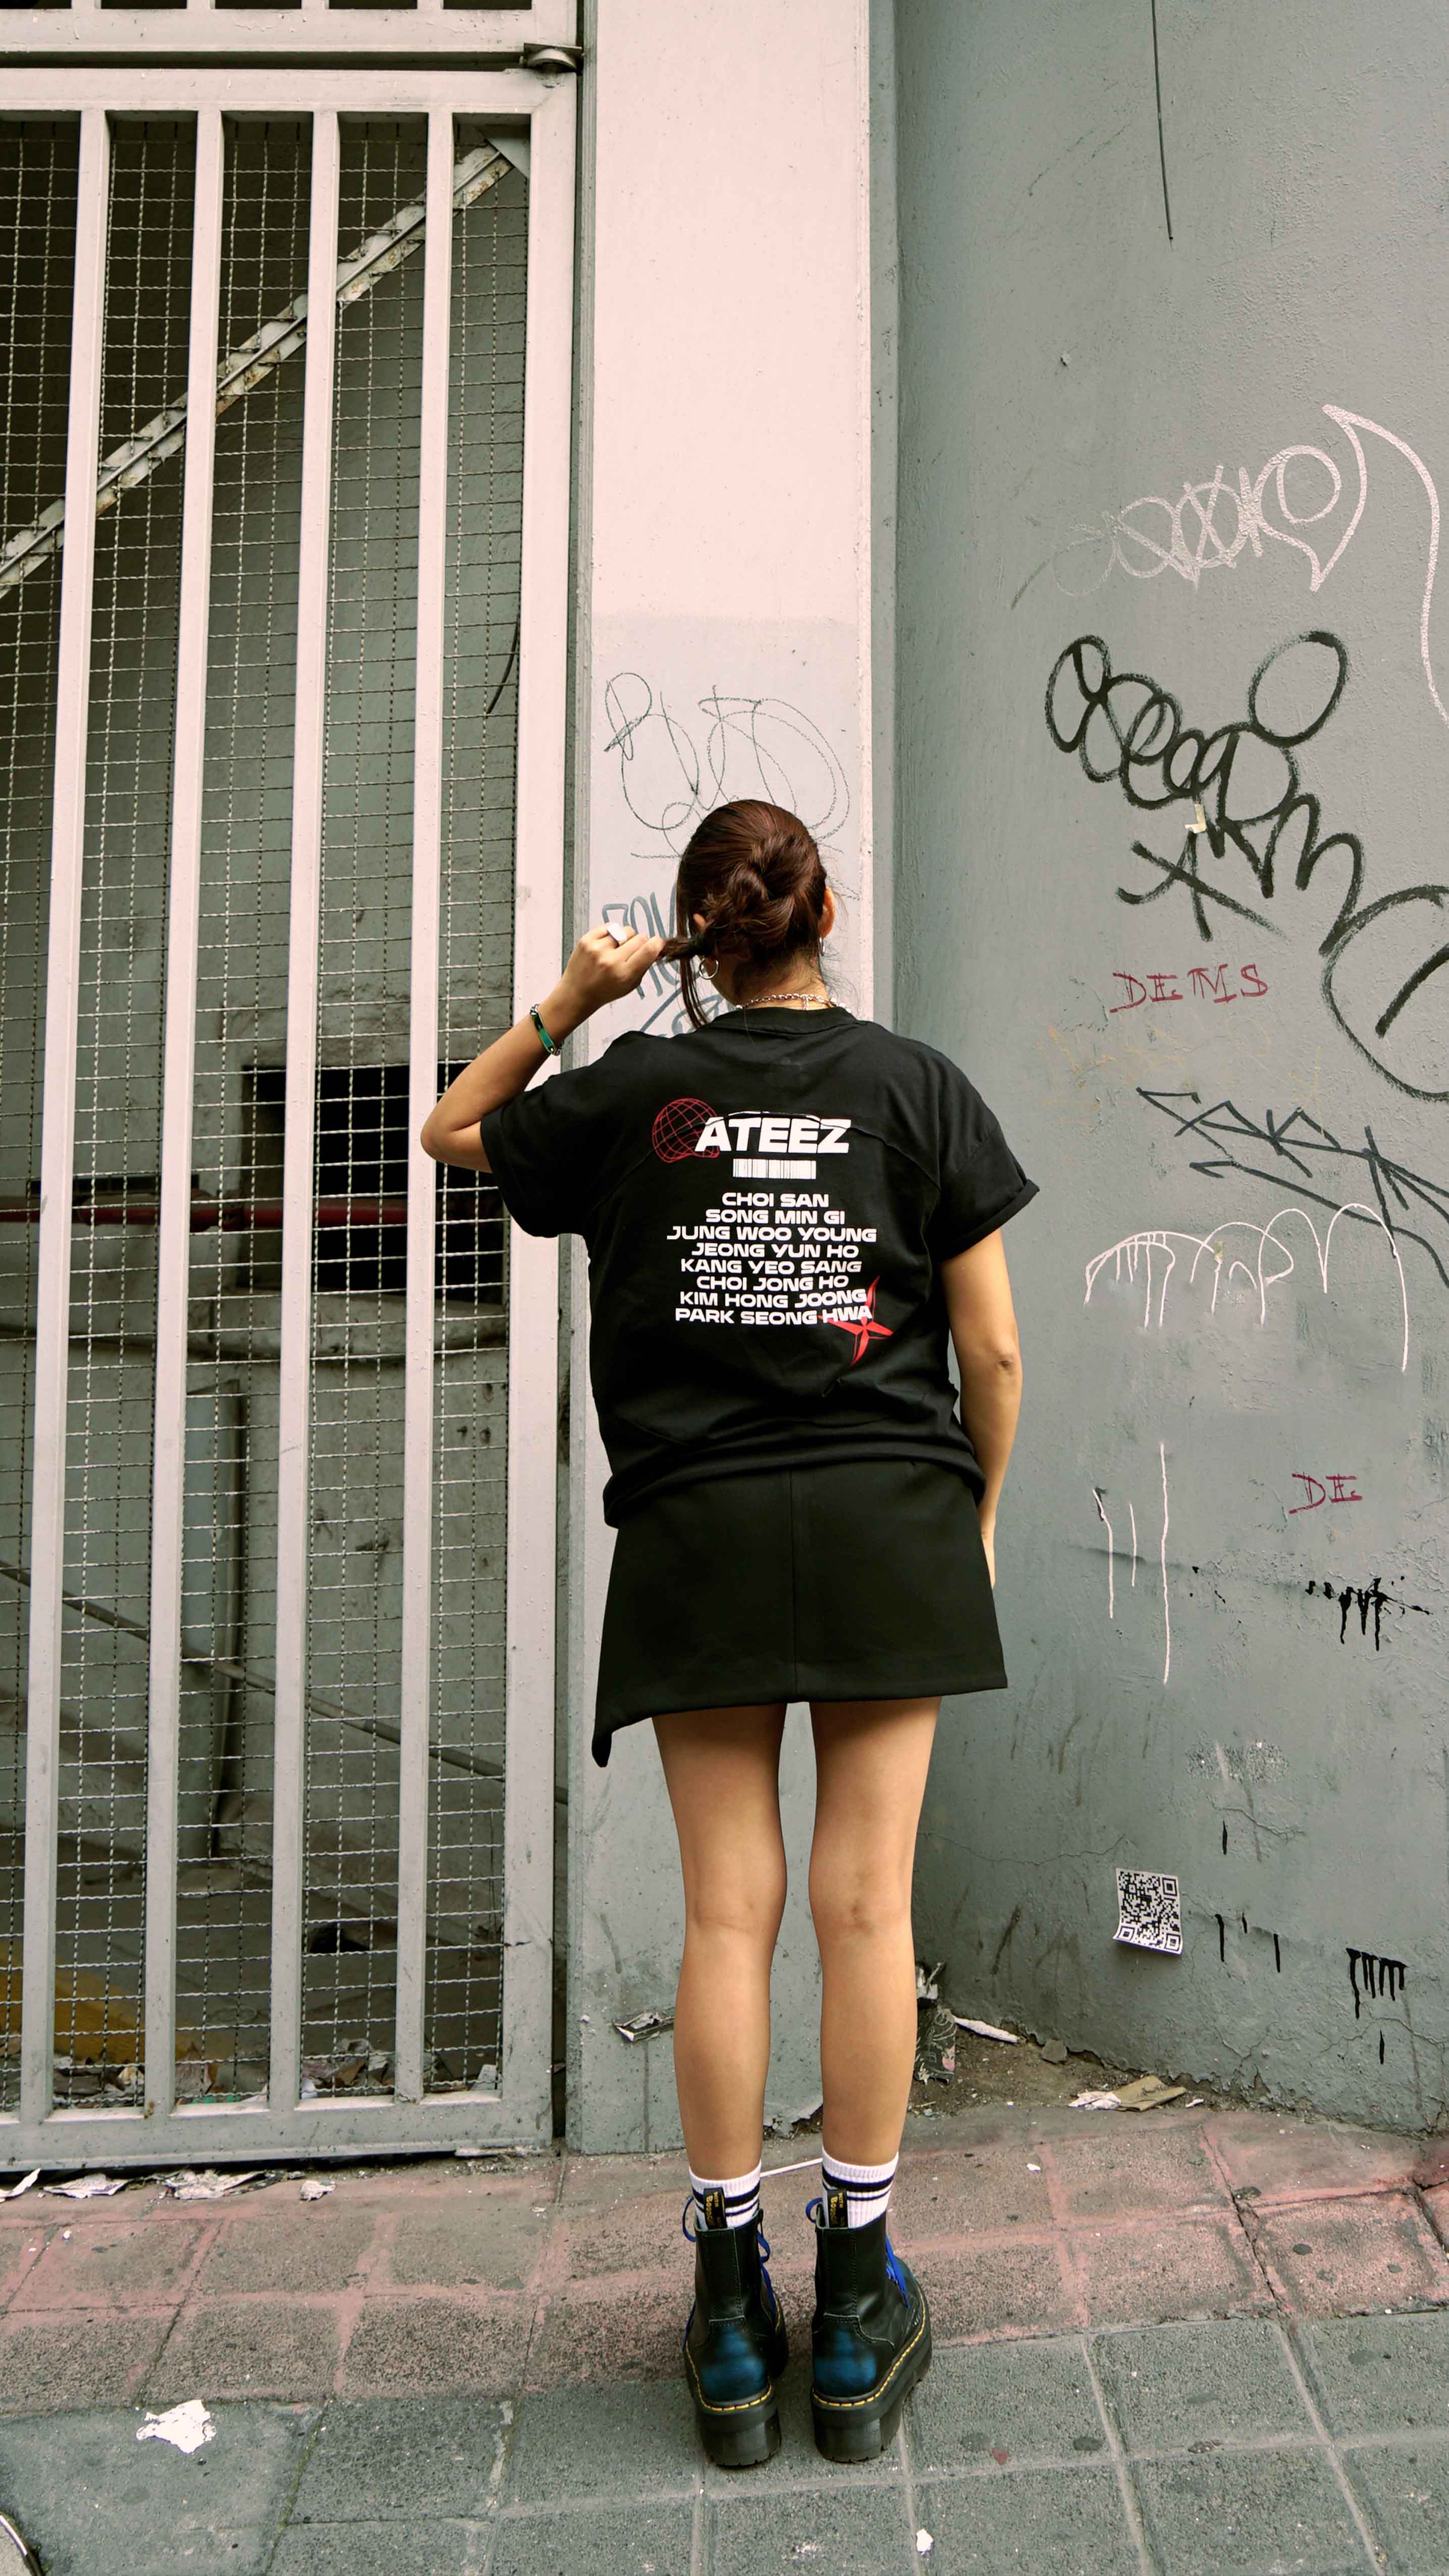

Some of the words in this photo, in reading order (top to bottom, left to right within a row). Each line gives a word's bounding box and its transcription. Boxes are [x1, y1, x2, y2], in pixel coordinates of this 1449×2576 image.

[695, 1111, 851, 1153] ATEEZ
[722, 1193, 774, 1207] CHOI
[781, 1194, 829, 1207] SAN
[706, 1209, 768, 1223] SONG
[775, 1210, 817, 1224] MIN
[824, 1211, 845, 1224] GI
[667, 1226, 730, 1240] JUNG
[737, 1227, 792, 1241] WOO
[798, 1227, 876, 1242] YOUNG
[692, 1243, 764, 1257] JEONG
[771, 1244, 820, 1258] YUN
[827, 1245, 859, 1258] HO
[681, 1259, 742, 1273] KANG
[748, 1261, 795, 1274] YEO
[801, 1261, 862, 1274] SANG
[697, 1276, 747, 1290] CHOI
[753, 1277, 813, 1291] JONG
[819, 1275, 849, 1289] HO
[681, 1292, 717, 1306] KIM
[725, 1294, 788, 1308] HONG
[795, 1289, 867, 1308] JOONG
[676, 1308, 734, 1323] PARK
[741, 1310, 817, 1325] SEONG
[822, 1305, 873, 1324] HWA
